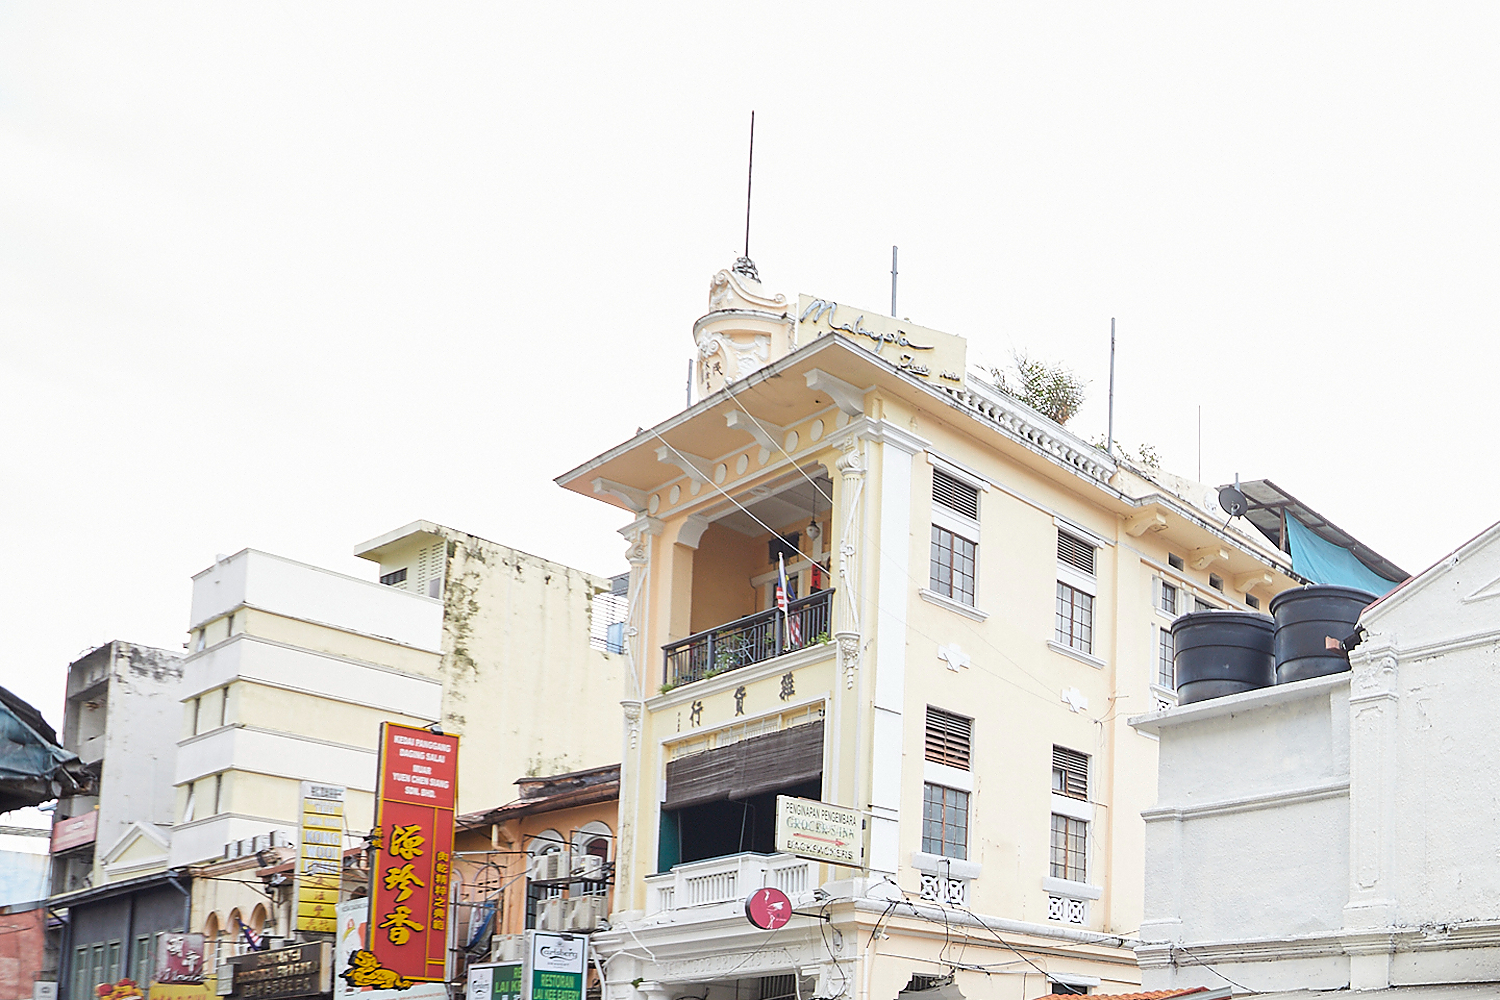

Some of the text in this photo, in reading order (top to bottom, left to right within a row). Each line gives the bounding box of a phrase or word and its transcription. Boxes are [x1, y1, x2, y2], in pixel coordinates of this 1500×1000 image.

[425, 752, 446, 763] SALAI
[785, 802, 857, 826] PENGINAPAN PENGEMBARA
[305, 830, 340, 845] KONG
[786, 840, 853, 860] BACKPACKERS
[379, 823, 425, 946] 源珍香
[540, 945, 578, 960] Carlsberg
[495, 980, 510, 993] LAI
[511, 980, 522, 992] KE
[541, 973, 575, 988] RESTORAN
[533, 988, 544, 1000] LAI
